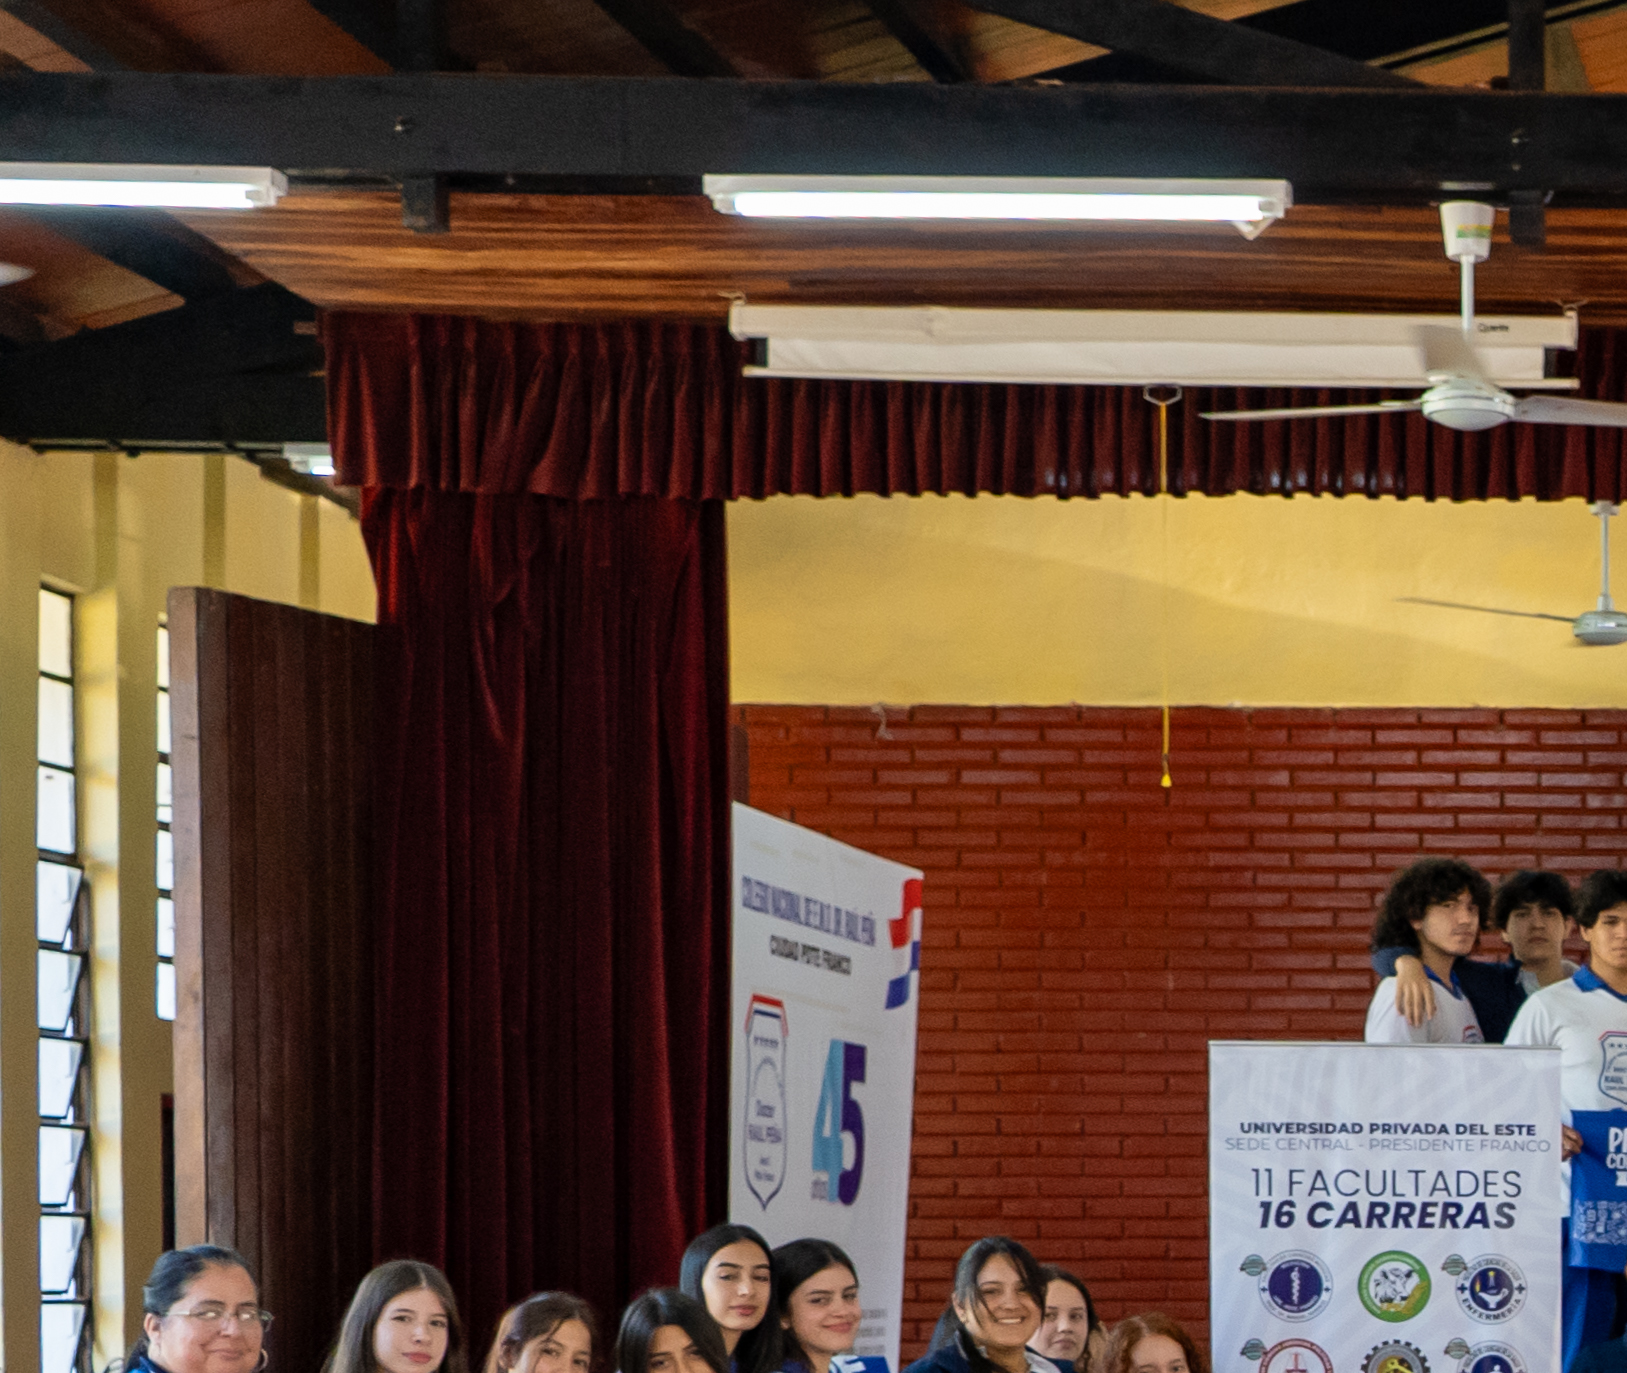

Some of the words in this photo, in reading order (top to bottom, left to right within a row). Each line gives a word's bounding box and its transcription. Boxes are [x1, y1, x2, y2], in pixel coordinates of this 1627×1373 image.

[1240, 1122, 1364, 1135] UNIVERSIDAD
[1369, 1122, 1450, 1135] PRIVADA
[1455, 1124, 1489, 1136] DEL
[1495, 1124, 1536, 1137] ESTE
[1225, 1138, 1271, 1151] SEDE
[1275, 1138, 1354, 1151] CENTRAL
[1369, 1138, 1475, 1152] PRESIDENTE
[1480, 1139, 1551, 1153] FRANCO
[1251, 1169, 1273, 1197] 11
[1288, 1169, 1522, 1198] FACULTADES
[1259, 1201, 1296, 1229] 16
[1307, 1201, 1517, 1229] CARRERAS
